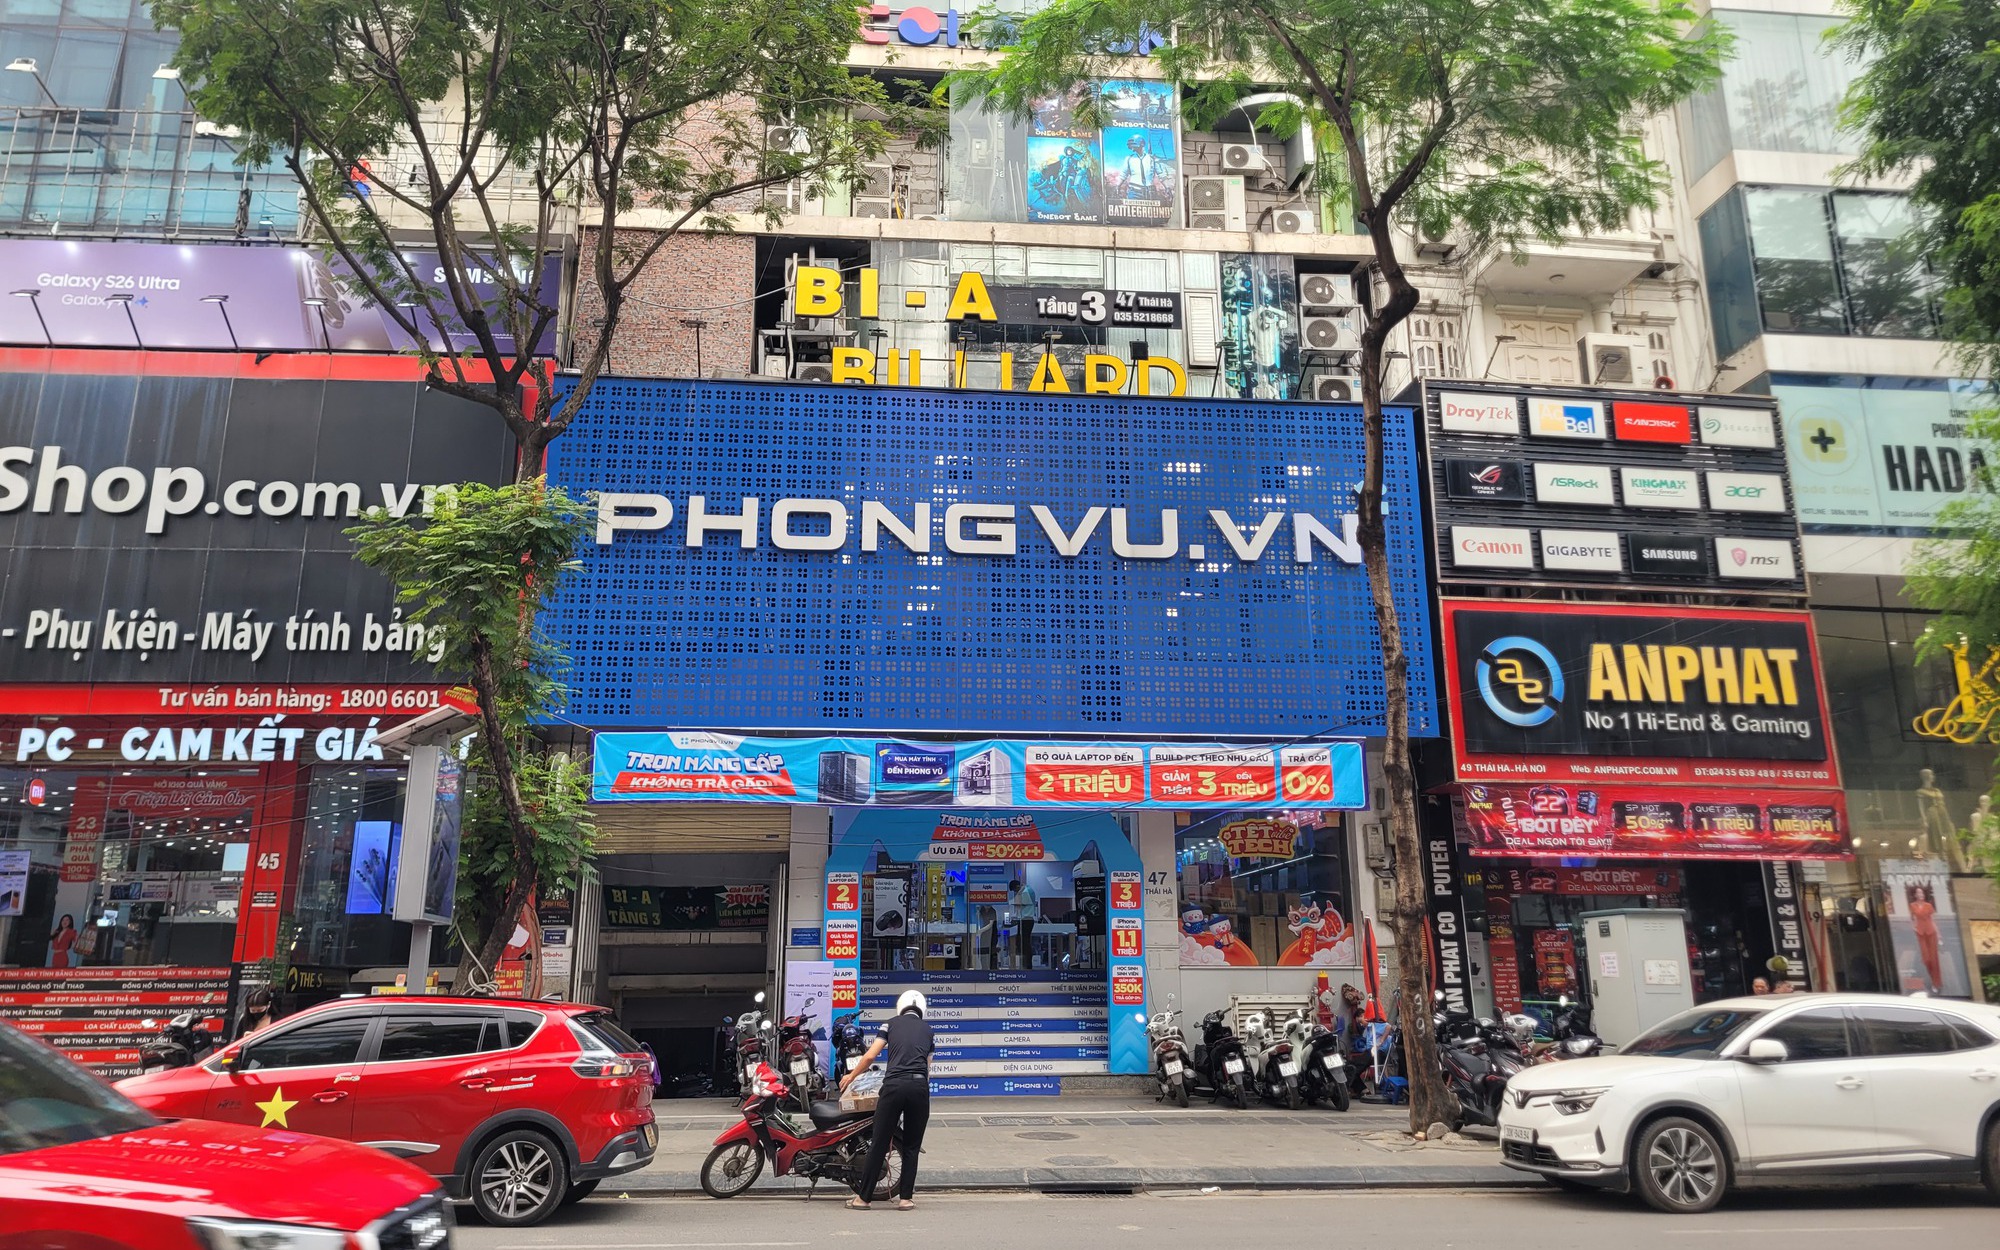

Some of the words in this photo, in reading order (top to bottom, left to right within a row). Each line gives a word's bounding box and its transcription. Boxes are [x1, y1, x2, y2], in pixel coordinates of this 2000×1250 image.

[37, 272, 103, 294] Galaxy
[105, 275, 136, 289] S26
[138, 274, 181, 291] Ultra
[795, 266, 878, 318] BI
[946, 271, 999, 321] A
[1115, 291, 1136, 308] 47
[1138, 296, 1158, 308] Thái
[1160, 296, 1173, 308] Hà
[1037, 296, 1078, 319] Tầng
[1081, 290, 1106, 323] 3
[1114, 312, 1132, 323] 035
[1133, 312, 1174, 325] 5218668
[1446, 403, 1514, 422] DrayTek
[1624, 417, 1678, 429] SANDISK
[1722, 424, 1771, 433] SEAGATE
[1550, 477, 1598, 489] ASRock
[1631, 478, 1688, 490] KINGMAX
[1725, 484, 1767, 498] acer
[597, 492, 1361, 565] PHONGVU.VN
[1462, 539, 1524, 556] Canon
[1546, 545, 1613, 559] GIGABYTE
[1642, 548, 1697, 561] SAMSUNG
[1750, 554, 1780, 566] msi
[25, 608, 90, 661] Phụ
[102, 607, 178, 662] kiện
[201, 608, 274, 661] Máy
[285, 608, 350, 652] tính
[362, 606, 447, 662] bảng
[1588, 642, 1799, 706] ANPHAT
[158, 687, 186, 708] Tư
[191, 686, 231, 708] vấn
[234, 687, 272, 708] bán
[275, 687, 332, 712] hàng:
[340, 689, 388, 708] 1800
[390, 689, 440, 709] 6601
[1585, 711, 1614, 730] No
[1619, 712, 1630, 730] 1
[1638, 711, 1706, 732] Hi-End
[1710, 713, 1727, 732] &
[1732, 713, 1811, 739] Gaming
[17, 727, 76, 762] PC
[120, 727, 211, 762] CAM
[223, 714, 304, 762] KẾT
[315, 716, 385, 761] GIÁ
[627, 750, 683, 770] TRỌN
[684, 752, 742, 772] NÂNG
[743, 750, 785, 773] CẤP
[894, 755, 907, 763] MUA
[909, 754, 922, 763] MÁY
[923, 754, 936, 763] TÍNH
[1035, 752, 1049, 763] BỘ
[1052, 751, 1072, 763] QUÀ
[1074, 753, 1111, 762] LAPTOP
[1113, 751, 1134, 762] ĐẾN
[1155, 753, 1182, 762] BUILD
[1185, 754, 1197, 762] PC
[1200, 754, 1225, 762] THEO
[1227, 754, 1247, 762] NHU
[1287, 752, 1305, 763] TRẢ
[1307, 752, 1327, 764] GÓP
[887, 765, 903, 775] ĐẾN
[904, 766, 929, 775] PHONG
[931, 765, 943, 776] VŨ
[1461, 763, 1473, 772] 49
[1474, 763, 1495, 773] THÁI
[1594, 765, 1678, 776] ANPHATPC.COM.VN
[1738, 769, 1756, 778] 639
[630, 774, 694, 789] KHÔNG
[696, 773, 728, 790] TRẢ
[1162, 771, 1190, 783] GIẢM
[1235, 771, 1252, 781] ĐẾN
[1038, 773, 1055, 792] 2
[1058, 771, 1132, 796] TRIỆU
[1161, 783, 1192, 796] THÊM
[1197, 771, 1215, 796] 3
[1222, 780, 1268, 799] TRIỆU
[1285, 773, 1331, 796] 0%
[1469, 802, 1494, 810] ANPHAT
[76, 816, 97, 830] 23
[1505, 837, 1535, 846] DEAL
[933, 845, 947, 855] ƯU
[949, 845, 966, 855] ĐÃI
[986, 843, 1041, 858] 50%++
[257, 852, 281, 871] 45
[67, 865, 90, 874] 100%
[1148, 871, 1168, 886] 47
[612, 888, 628, 904] BI
[641, 890, 652, 905] A
[836, 884, 850, 902] 2
[1119, 883, 1133, 901] 3
[1145, 887, 1162, 895] THÁI
[1163, 887, 1173, 895] HÀ
[1116, 901, 1137, 910] TRIỆU
[608, 906, 648, 925] TẦNG
[652, 913, 661, 925] 3
[1117, 930, 1137, 948] 1.1
[827, 946, 857, 956] 400K
[1441, 940, 1464, 984] PHAT
[1114, 984, 1142, 993] 350K
[1446, 988, 1469, 1014] AN
[943, 1010, 963, 1018] THOẠI
[945, 1036, 962, 1044] PHÍM
[1003, 1064, 1019, 1072] ĐIỆN
[1034, 1064, 1053, 1072] DỤNG
